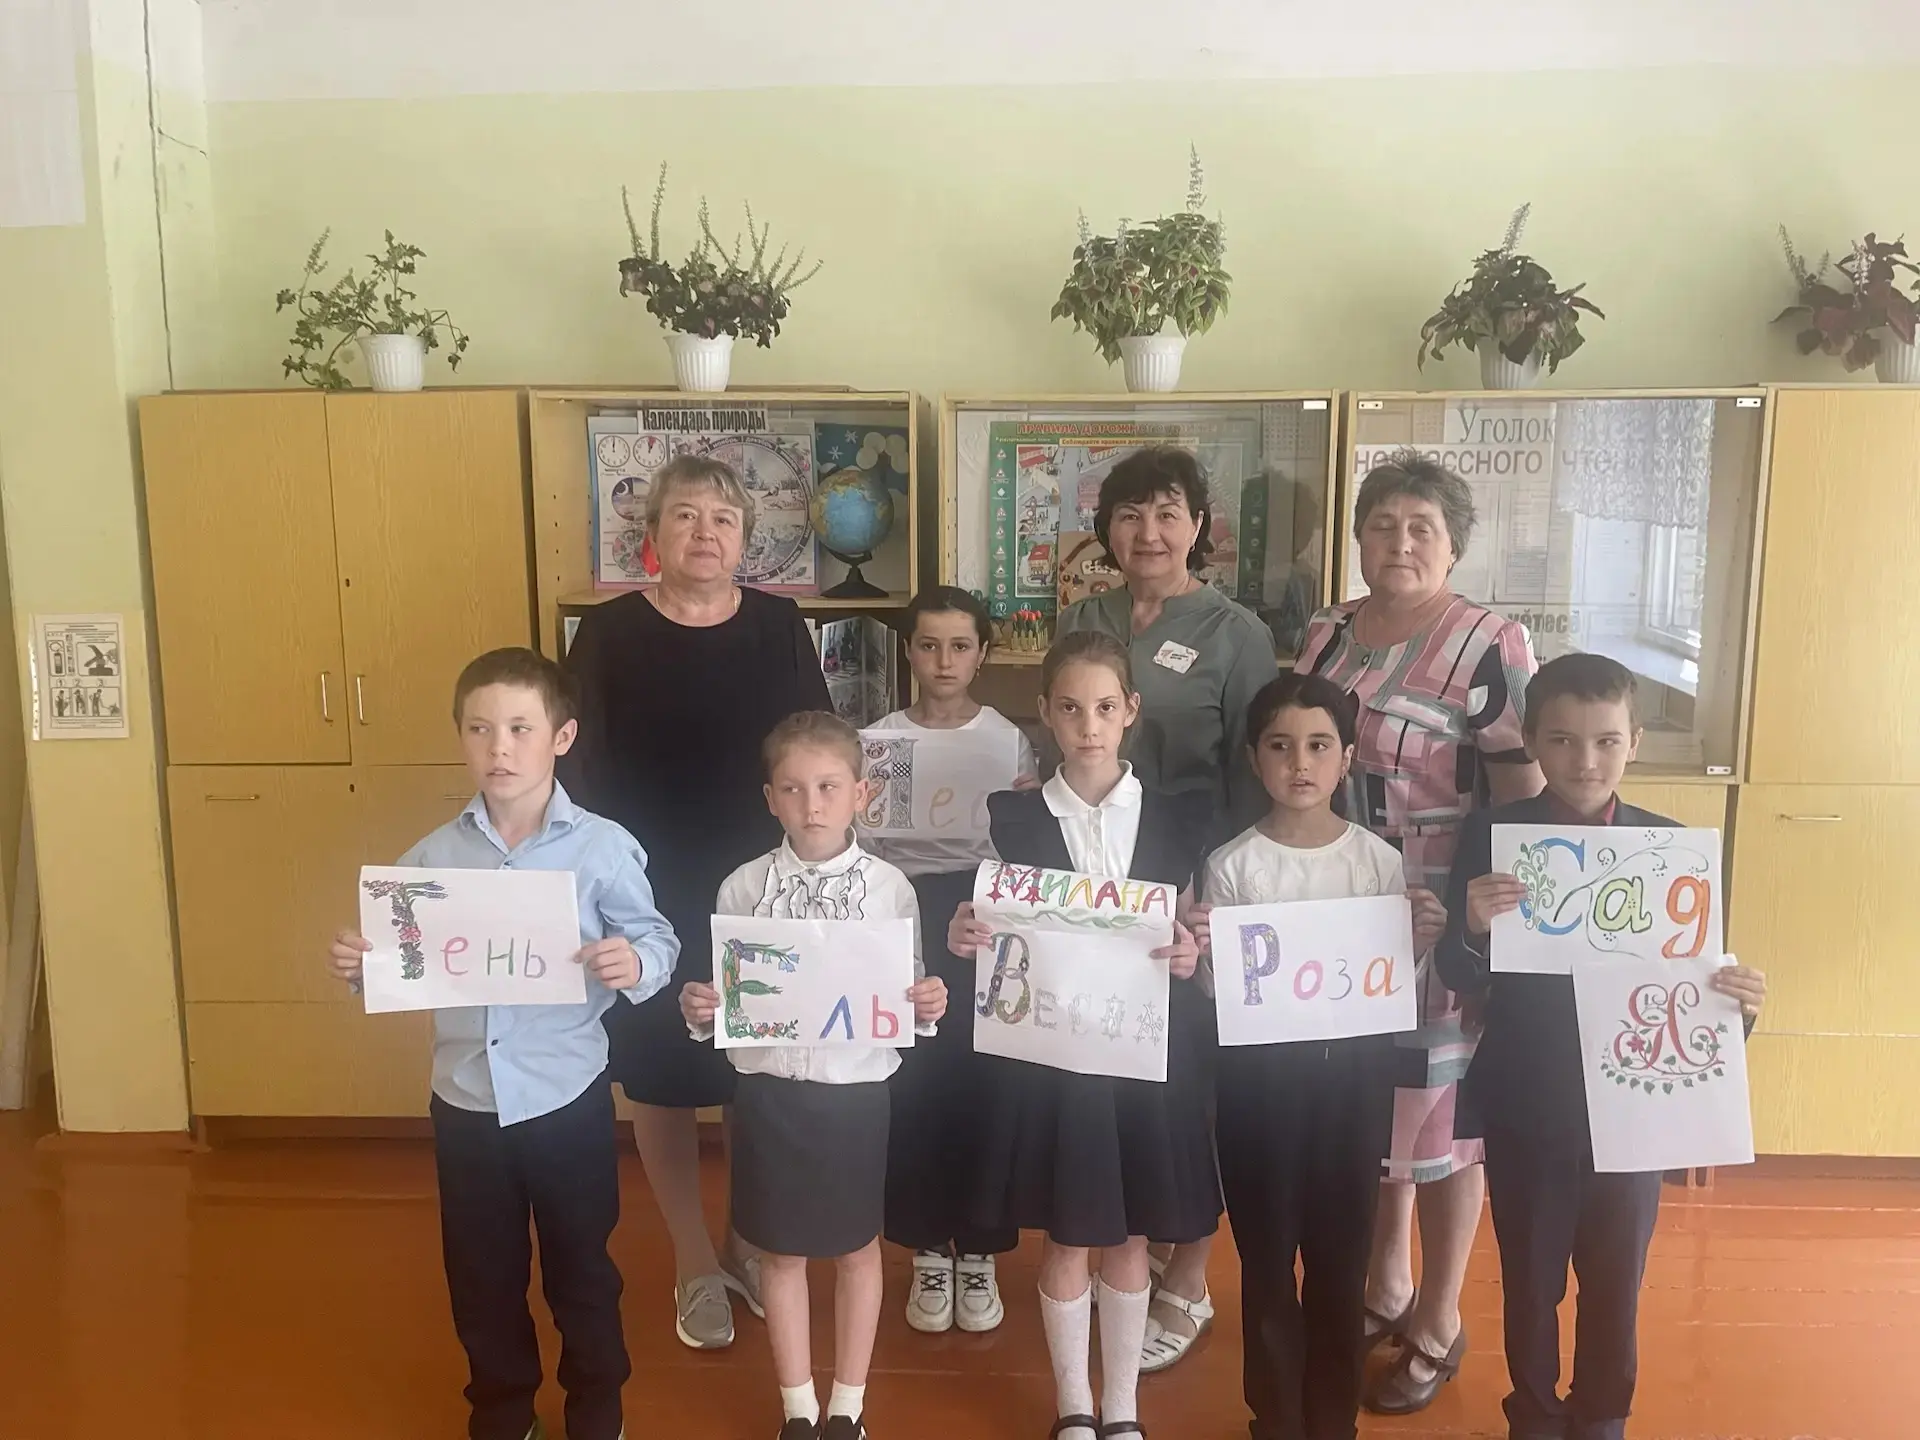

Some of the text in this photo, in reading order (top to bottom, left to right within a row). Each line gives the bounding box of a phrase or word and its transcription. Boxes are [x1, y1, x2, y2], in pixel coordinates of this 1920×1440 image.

[641, 410, 766, 434] Календарь природы
[1016, 423, 1079, 435] ПРАВИЛА
[1458, 407, 1556, 444] Уголок
[1238, 923, 1403, 1006] Роза
[721, 938, 899, 1040] Ель
